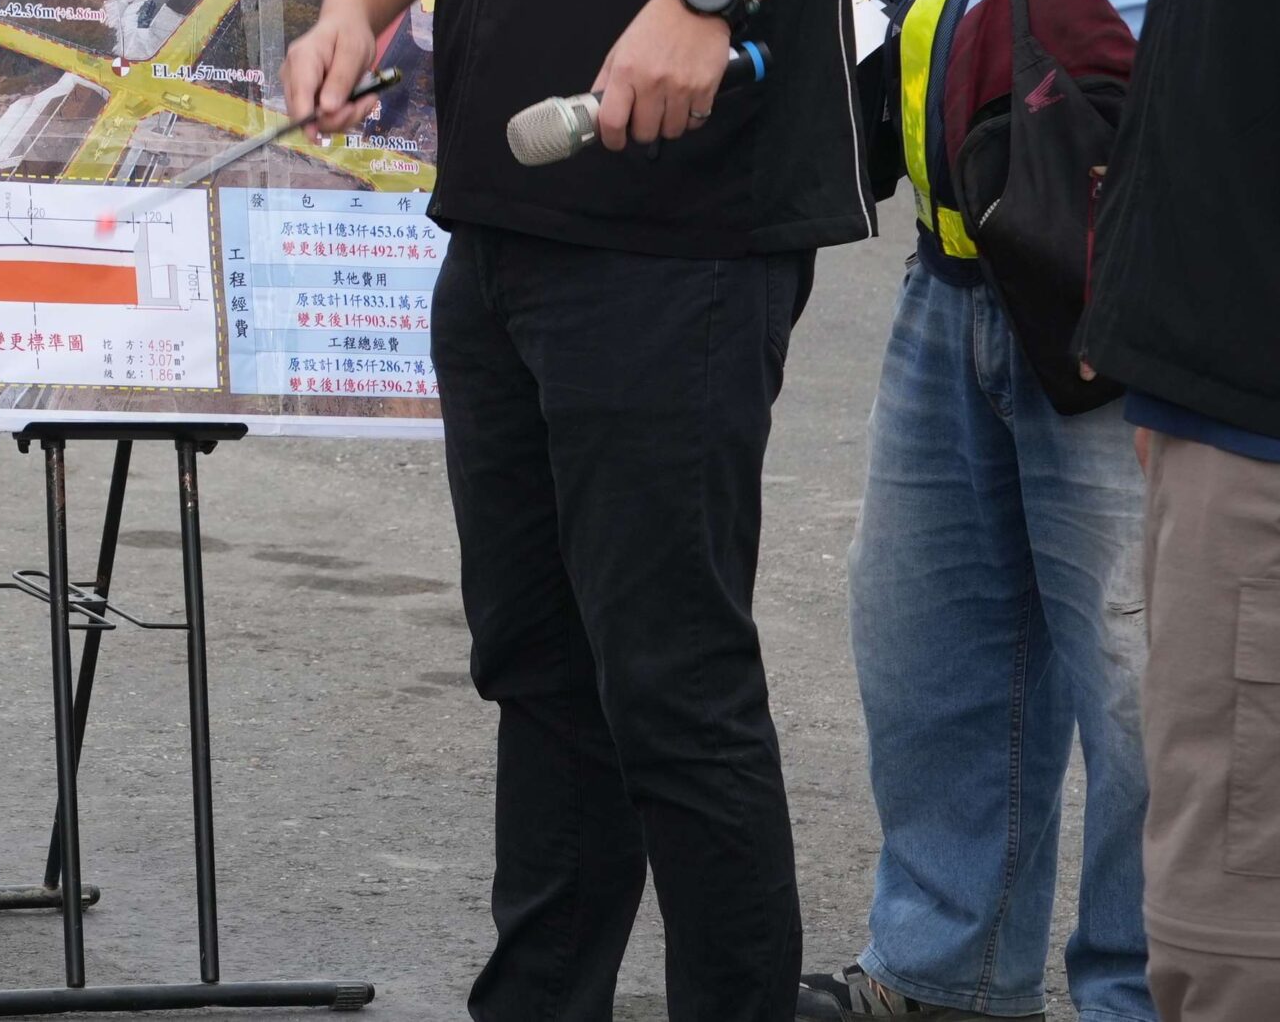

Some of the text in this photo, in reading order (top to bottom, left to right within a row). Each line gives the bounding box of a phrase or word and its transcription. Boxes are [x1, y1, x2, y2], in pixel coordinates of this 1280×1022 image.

[280, 221, 436, 240] 原設計1億3仟453.6萬元
[282, 241, 437, 260] 變更後1億4仟492.7萬元
[332, 271, 387, 287] 其他費用
[296, 292, 428, 309] 原設計1仟833.1萬元
[297, 311, 429, 329] 變更後1仟903.5萬元
[328, 336, 399, 353] 工程總經費
